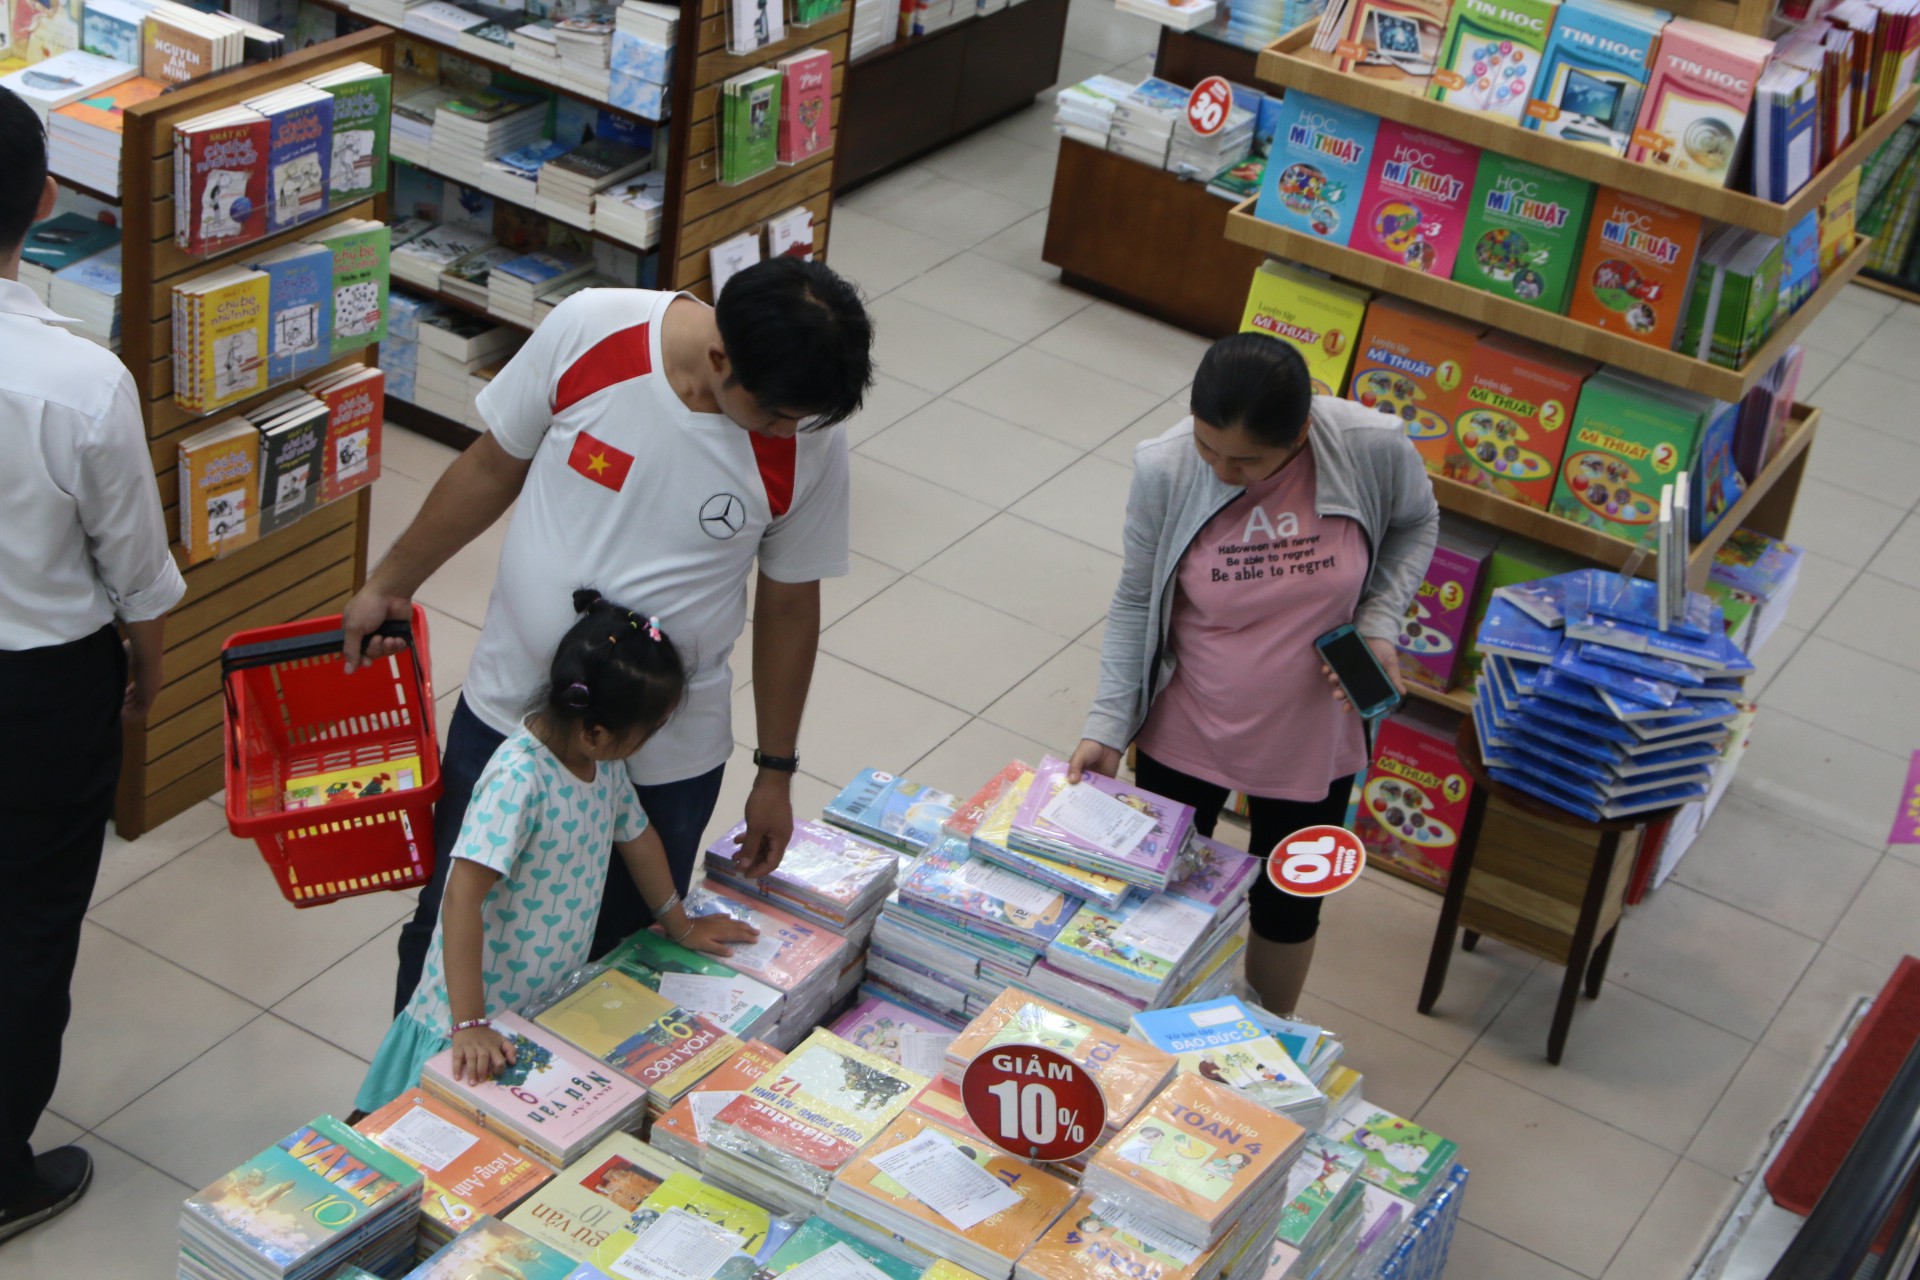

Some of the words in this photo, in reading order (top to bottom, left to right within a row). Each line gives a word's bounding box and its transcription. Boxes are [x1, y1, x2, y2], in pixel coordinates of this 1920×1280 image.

[1466, 0, 1495, 17] TIN
[1559, 25, 1595, 46] TIN
[1667, 54, 1702, 76] TIN
[1299, 109, 1338, 133] HỌC
[1313, 132, 1365, 165] THUẬT
[1394, 144, 1436, 170] HỌC
[1408, 167, 1465, 202] THUẬT
[1496, 174, 1539, 197] HỌC
[1513, 195, 1570, 229] THUẬT
[1612, 205, 1653, 232] HỌC
[1425, 222, 1442, 237] 3
[1626, 228, 1681, 264] THUẬT
[1532, 250, 1550, 265] 2
[1648, 284, 1660, 299] 1
[1271, 319, 1322, 346] THUẬT
[1329, 331, 1341, 348] 1
[1390, 352, 1436, 379] THUẬT
[1442, 364, 1455, 383] 1
[1491, 392, 1539, 419] THUẬT
[1543, 403, 1560, 423] 2
[1602, 433, 1650, 460] THUẬT
[1659, 446, 1674, 466] 2
[1242, 505, 1299, 543] Aa
[1218, 542, 1269, 556] Halloween
[1272, 538, 1289, 549] will
[1292, 534, 1321, 547] never
[1226, 556, 1241, 567] Be
[1243, 554, 1265, 566] able
[1268, 552, 1280, 563] to
[1283, 547, 1316, 561] regret
[1211, 568, 1230, 583] Be
[1234, 566, 1264, 581] able
[1270, 565, 1284, 577] to
[1289, 556, 1336, 575] regret
[1446, 585, 1458, 603] 3
[1399, 766, 1441, 788] THUẬT
[1448, 779, 1461, 796] 4
[658, 1016, 693, 1039] 9
[1206, 1030, 1242, 1046] ĐỨC
[1236, 1020, 1261, 1039] 3
[992, 1052, 1074, 1083] GIẢM
[510, 1086, 539, 1105] 9
[751, 1086, 779, 1102] NINH
[769, 1076, 802, 1098] 12
[776, 1097, 796, 1109] AN
[988, 1079, 1085, 1144] 10%
[1192, 1100, 1212, 1114] Vở
[1211, 1110, 1236, 1127] bài
[1236, 1122, 1259, 1138] tập
[1243, 1142, 1263, 1155] 4
[473, 1152, 523, 1180] Tiếng
[451, 1174, 485, 1198] Anh
[302, 1194, 357, 1226] 10
[439, 1194, 472, 1221] 9
[579, 1204, 613, 1227] 10
[571, 1226, 611, 1248] gữ
